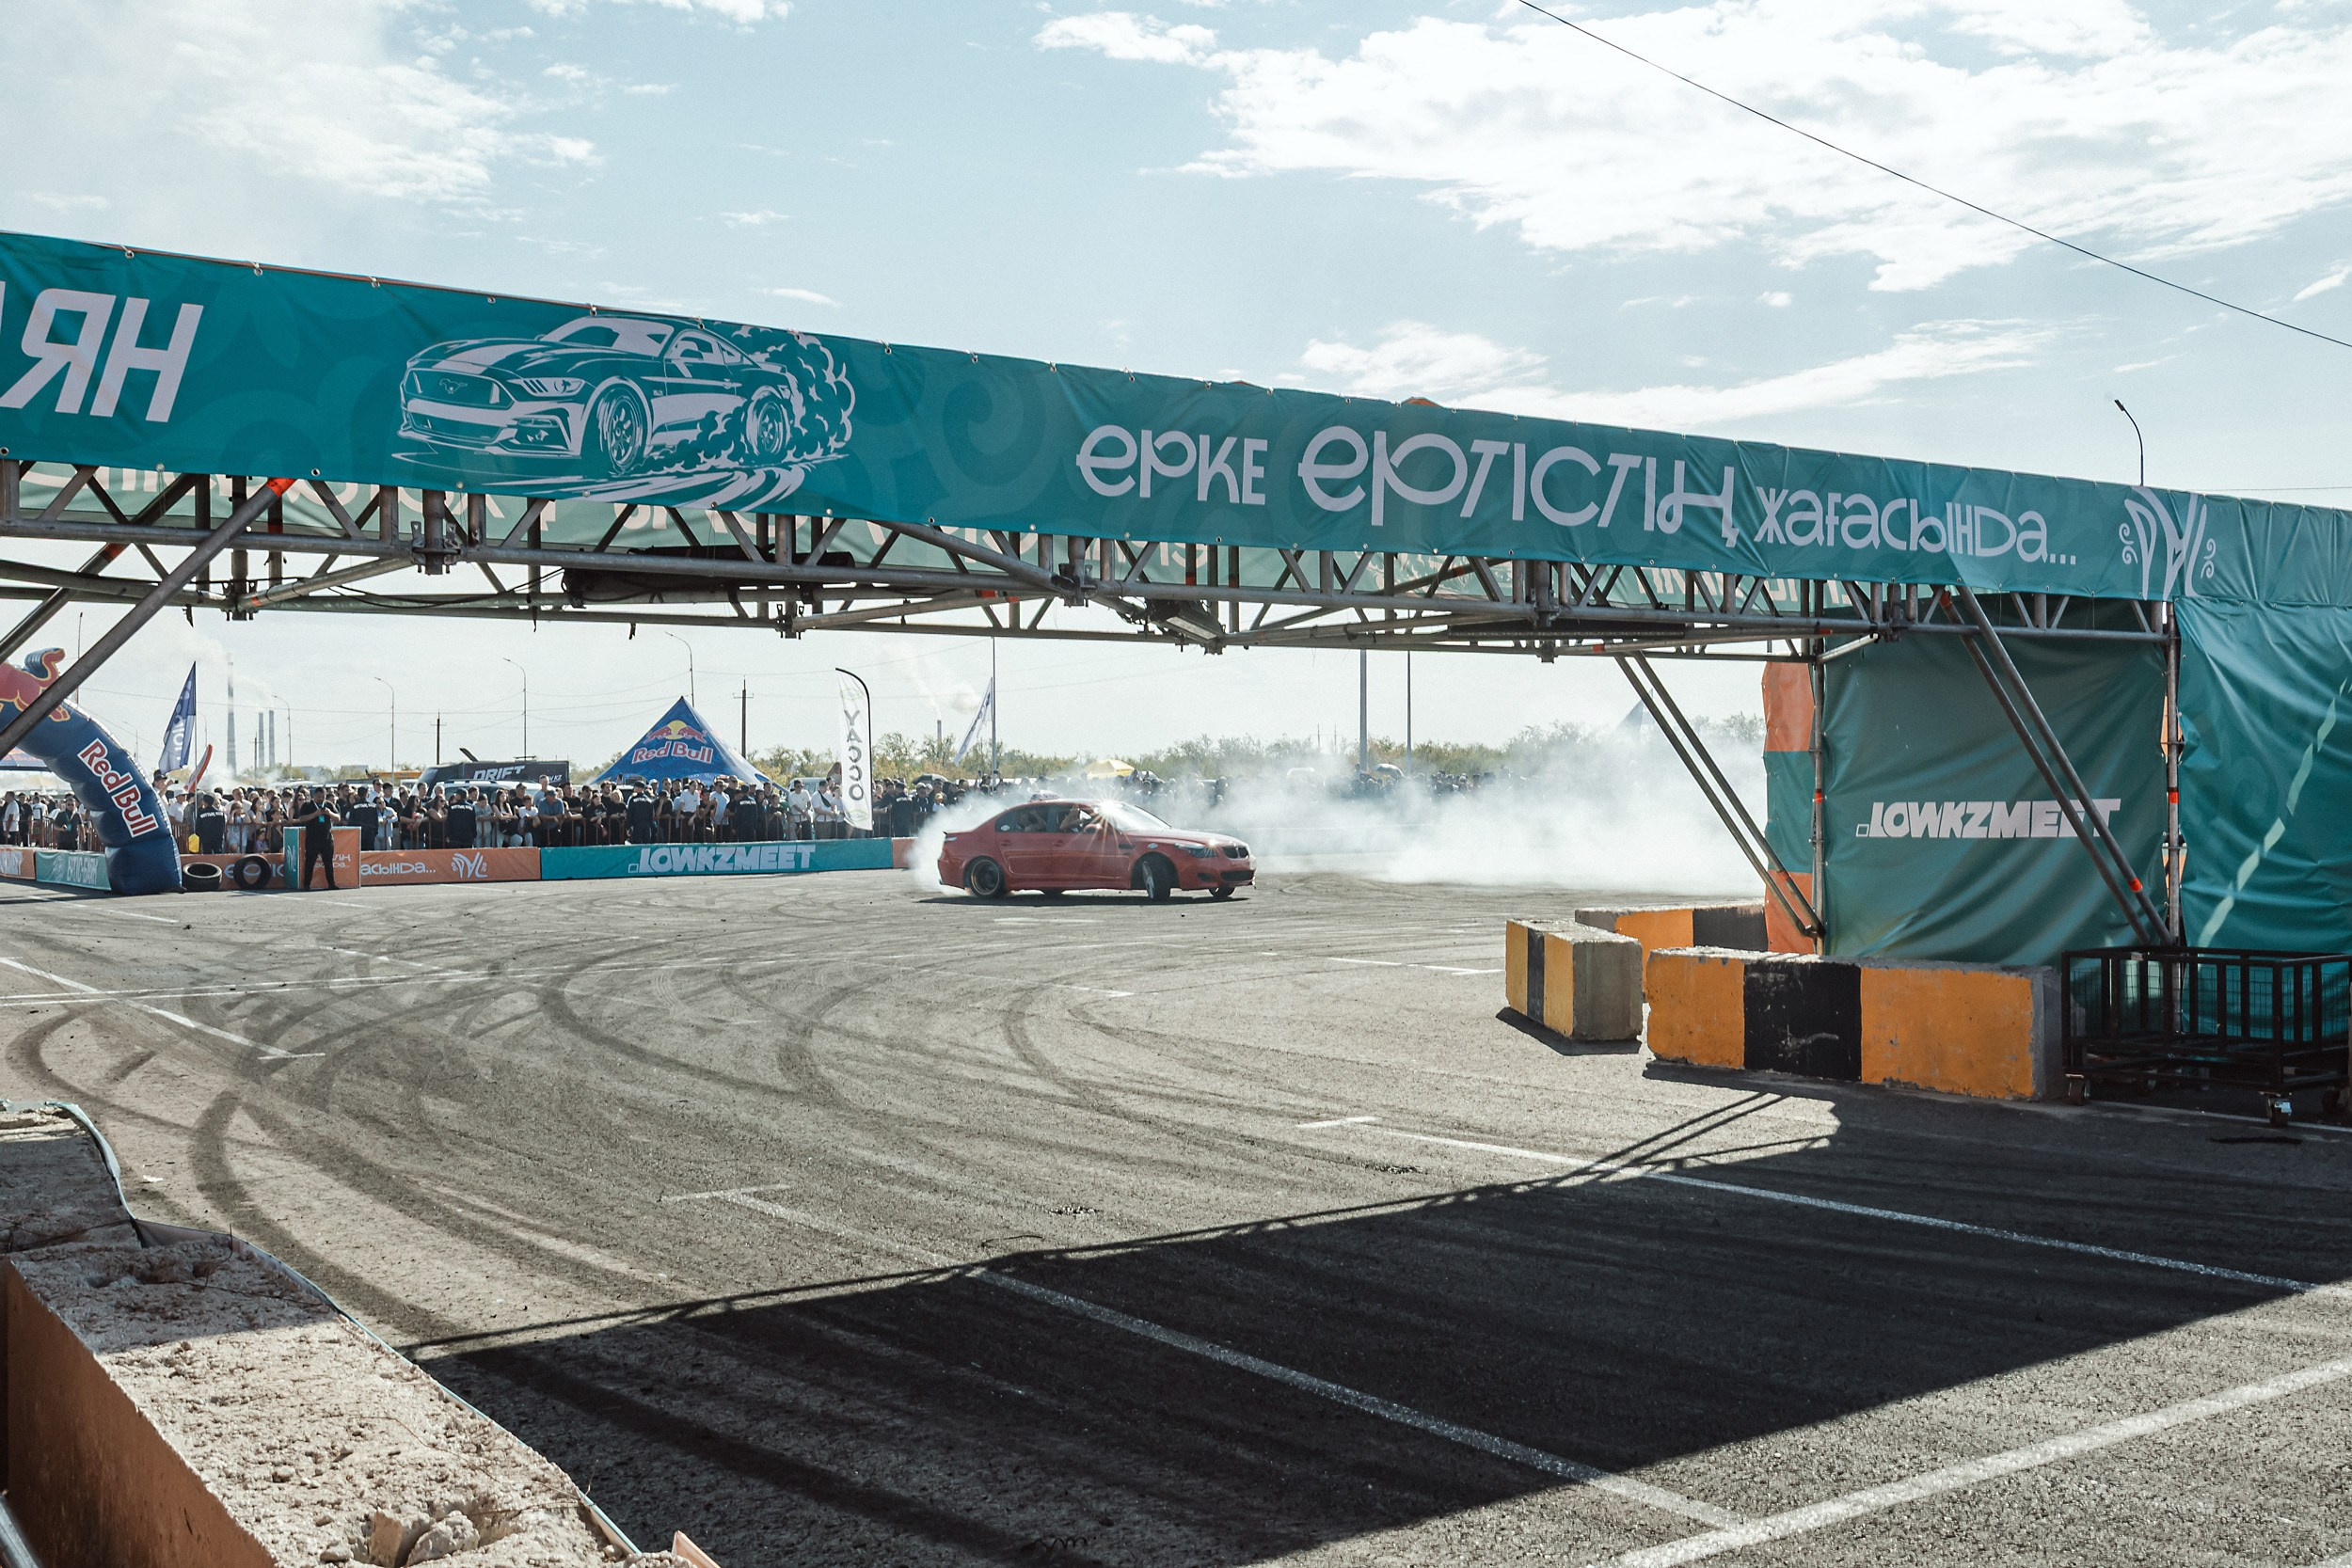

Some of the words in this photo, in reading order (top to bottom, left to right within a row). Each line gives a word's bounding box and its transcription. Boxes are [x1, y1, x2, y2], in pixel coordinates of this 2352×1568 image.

[0, 281, 204, 423] ЯН
[473, 765, 526, 781] DRIFT
[631, 740, 672, 764] Red
[671, 741, 714, 764] Bull
[77, 737, 133, 793] Red
[111, 784, 159, 838] Bull
